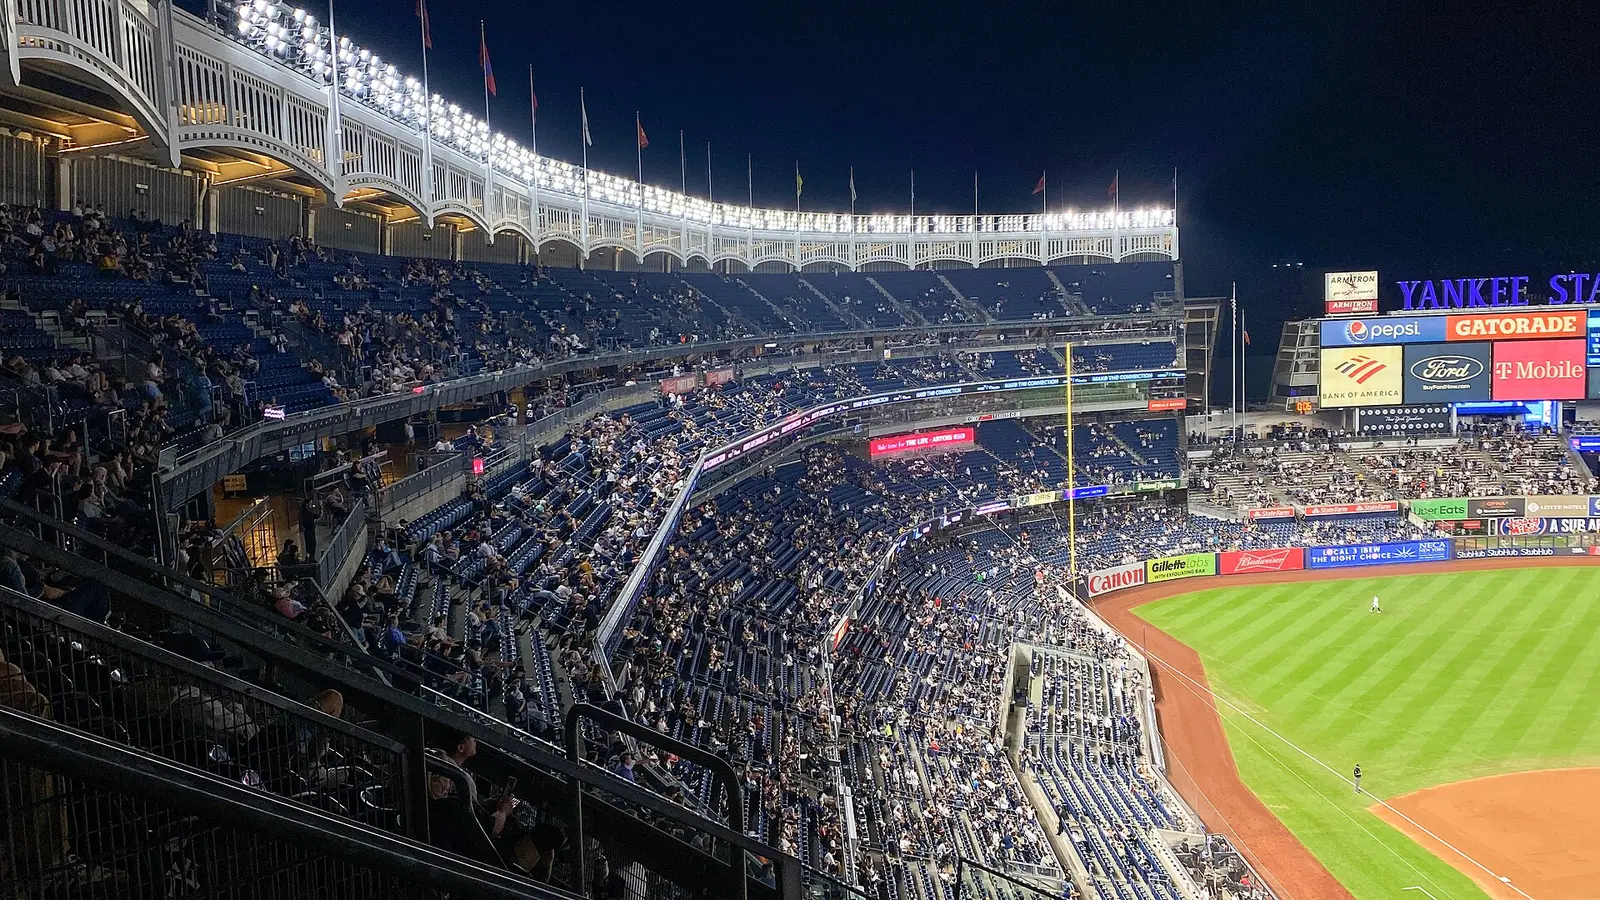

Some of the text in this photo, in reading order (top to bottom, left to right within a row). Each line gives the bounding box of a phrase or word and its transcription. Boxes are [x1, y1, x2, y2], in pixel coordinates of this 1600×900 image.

[1330, 275, 1376, 284] ARMITRON
[1396, 276, 1529, 310] YANKEE
[1332, 300, 1373, 308] ARMITRON
[1455, 316, 1577, 336] GATORADE
[1422, 358, 1469, 379] Ford
[1516, 360, 1583, 380] Mobile
[1322, 392, 1346, 400] BANK
[1359, 390, 1399, 398] AMERICA
[1413, 504, 1437, 516] Uber
[1439, 504, 1465, 516] Eats
[1549, 518, 1559, 532] A
[1561, 518, 1586, 532] SUB
[1419, 541, 1446, 549] NECA
[1322, 549, 1351, 557] LOCAL
[1360, 546, 1381, 555] IBEW
[1330, 554, 1362, 563] RIGHT
[1363, 552, 1392, 561] CHOICE
[1456, 547, 1553, 559] StubHub StubHub StubHub
[1241, 557, 1285, 568] Budweiser
[1088, 566, 1144, 594] Canon
